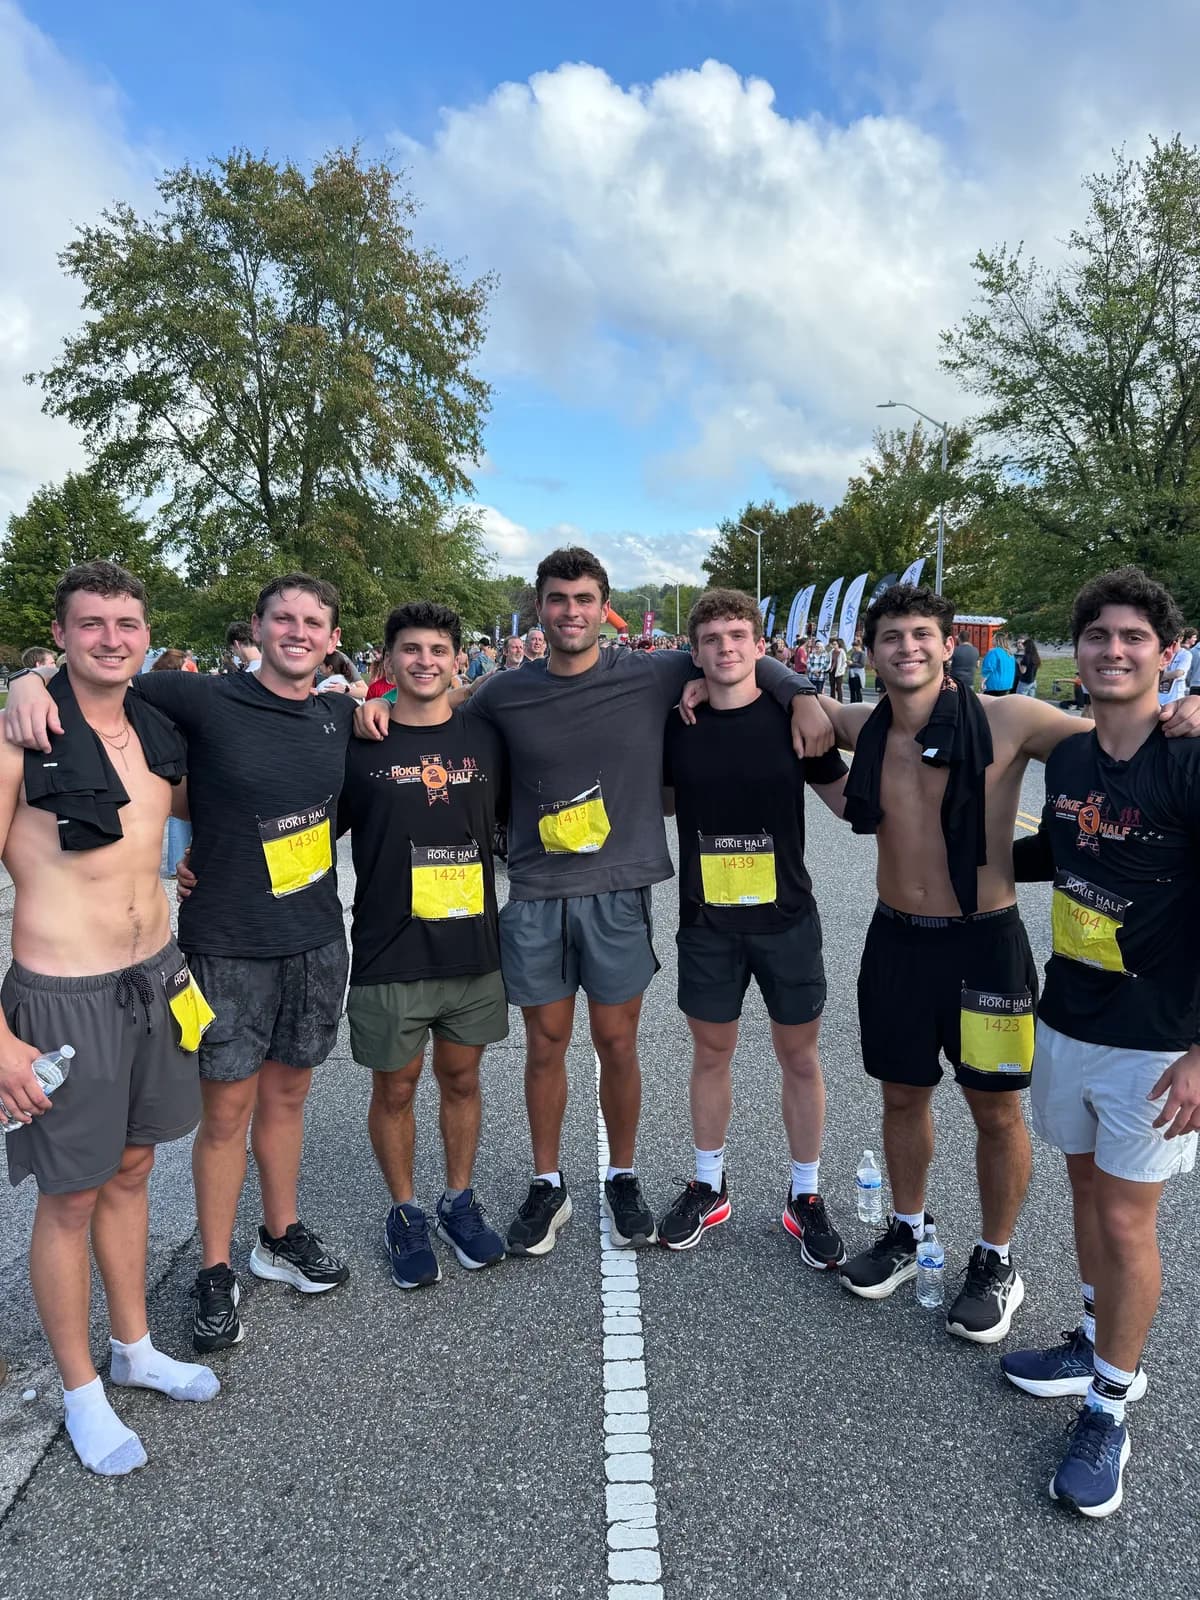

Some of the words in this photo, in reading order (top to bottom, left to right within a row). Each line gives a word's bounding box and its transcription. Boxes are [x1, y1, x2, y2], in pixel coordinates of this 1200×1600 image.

[391, 767, 421, 777] HOKIE
[448, 772, 473, 782] HALF
[277, 815, 307, 832] HOKIE
[558, 807, 587, 827] 1413
[1099, 822, 1131, 837] HALF
[288, 830, 320, 852] 1430
[715, 839, 743, 849] HOKIE
[744, 839, 767, 849] HALF
[427, 850, 456, 860] HOKIE
[457, 849, 479, 860] HALF
[721, 856, 755, 869] 1439
[432, 867, 467, 881] 1424
[1095, 894, 1124, 914] HALF
[1066, 902, 1101, 930] 1404
[979, 997, 1012, 1009] HOKIE
[1012, 998, 1032, 1009] HALF
[984, 1017, 1020, 1032] 1423
